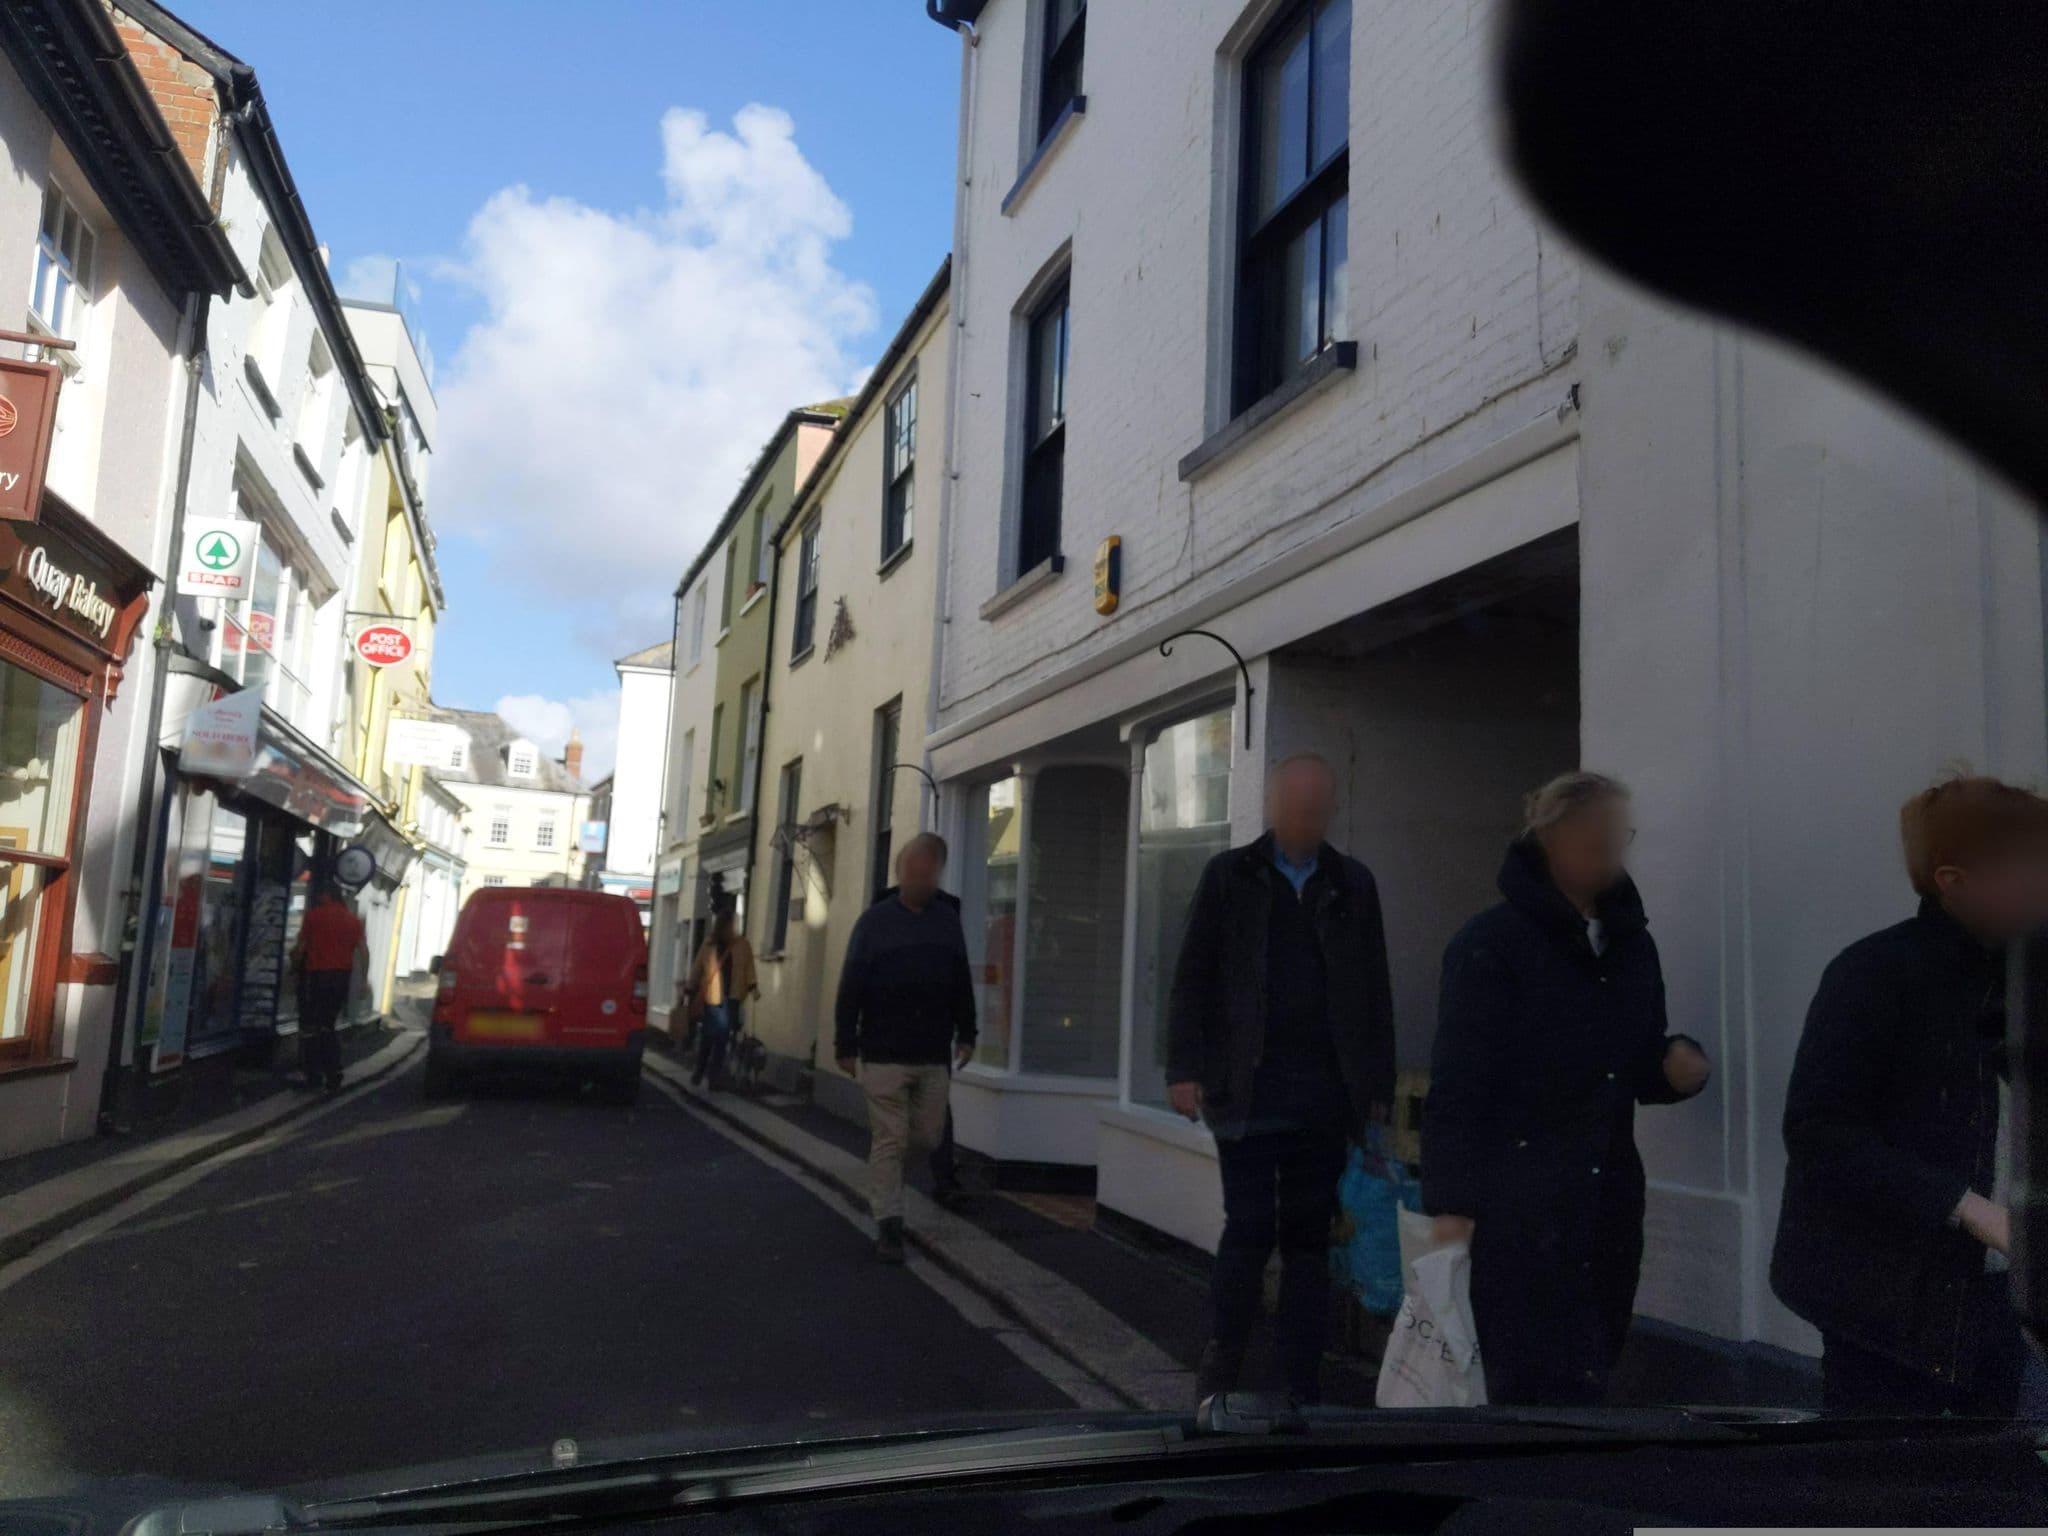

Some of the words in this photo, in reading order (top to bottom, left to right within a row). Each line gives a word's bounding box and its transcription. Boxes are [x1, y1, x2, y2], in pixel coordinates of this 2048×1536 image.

[190, 572, 239, 587] SPAR
[28, 546, 71, 610] Quay
[69, 574, 116, 639] Bakery
[370, 632, 401, 646] POST
[361, 643, 404, 657] OFFICE
